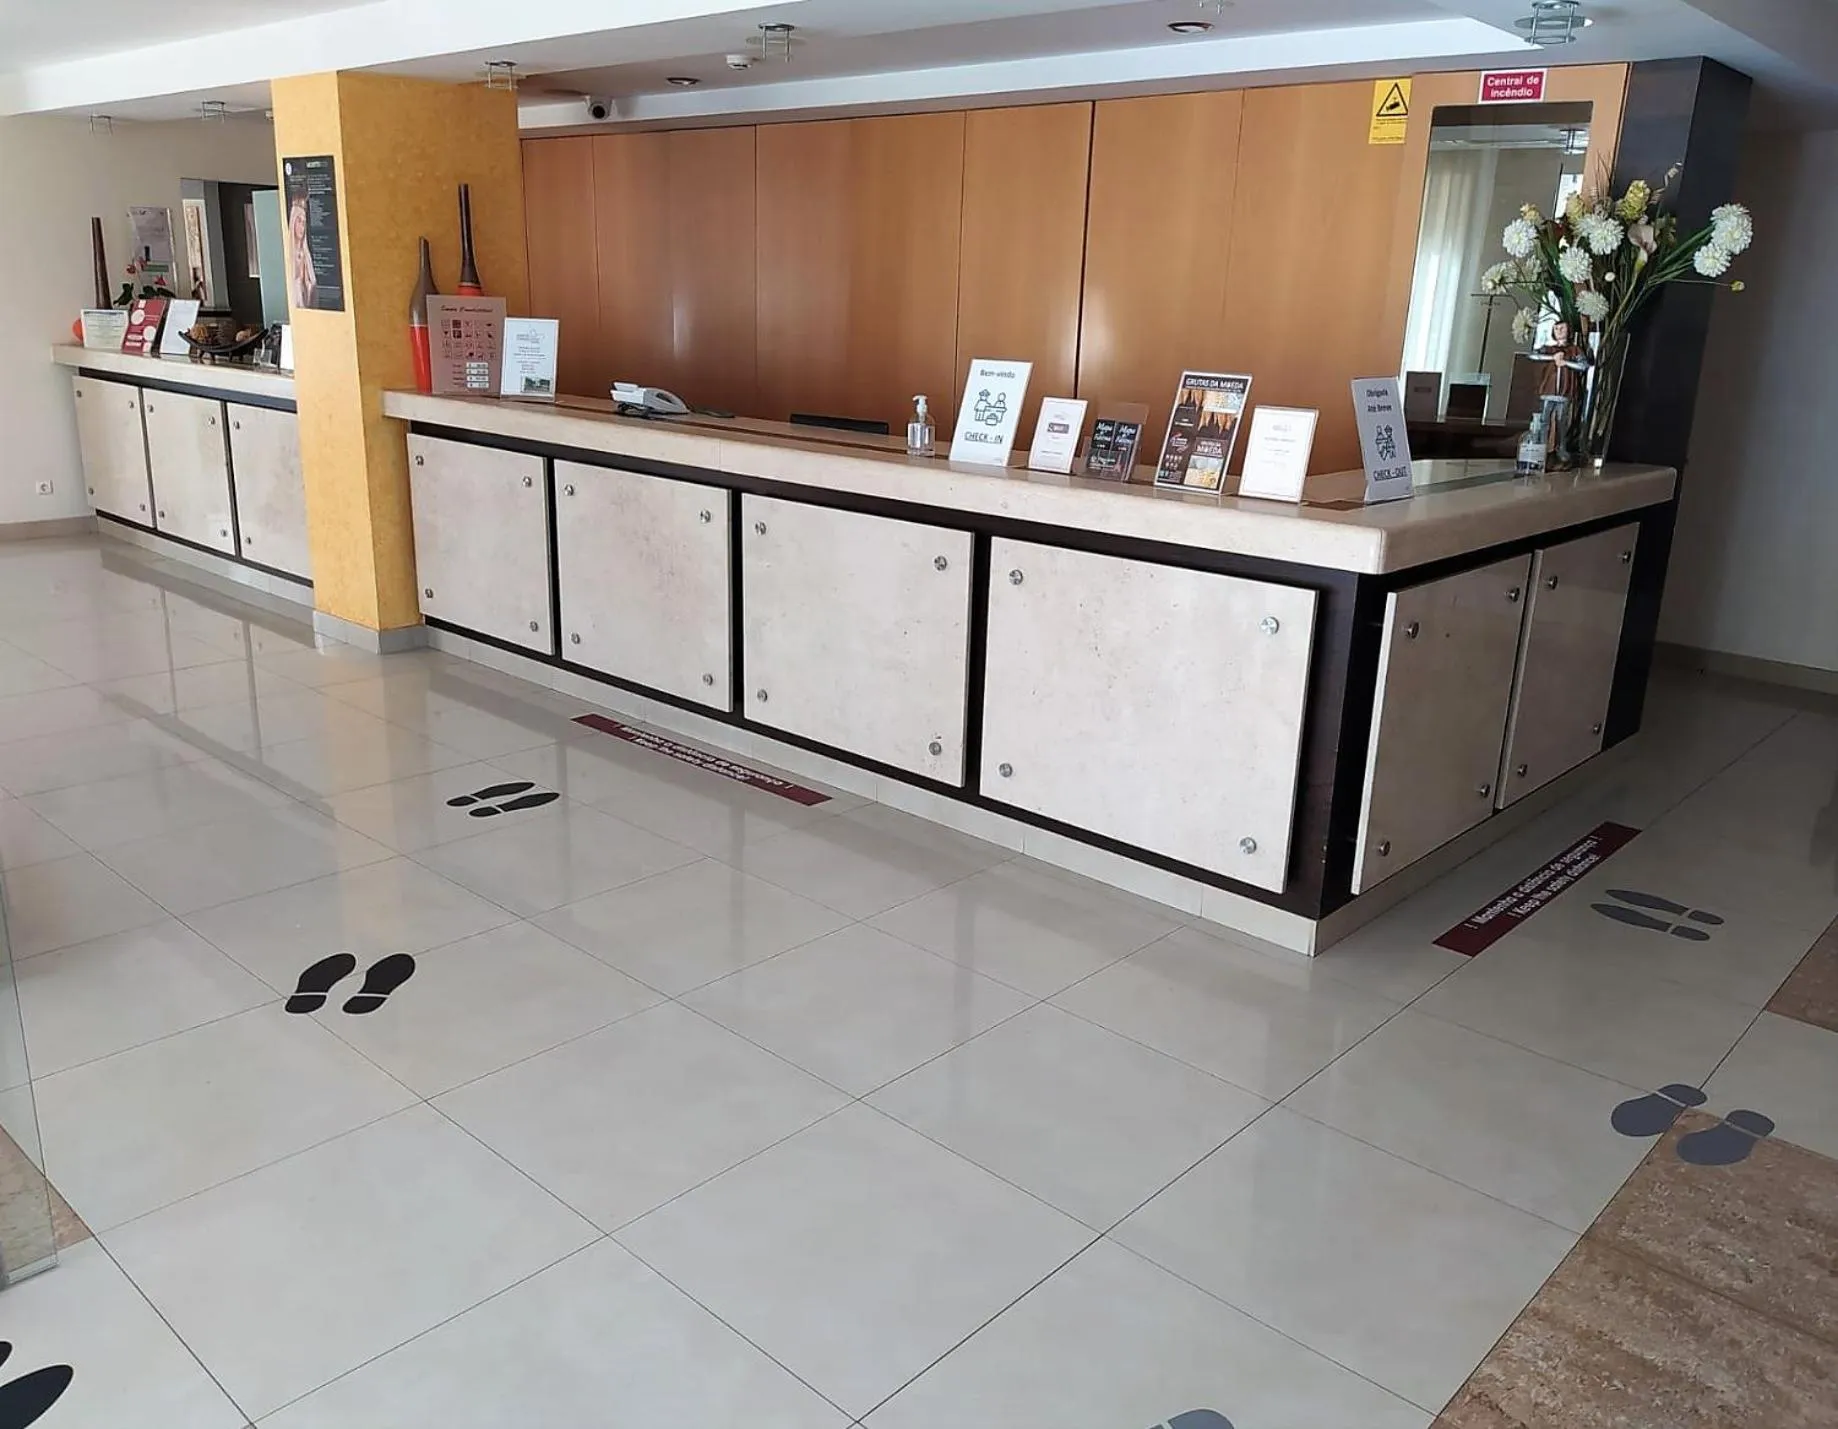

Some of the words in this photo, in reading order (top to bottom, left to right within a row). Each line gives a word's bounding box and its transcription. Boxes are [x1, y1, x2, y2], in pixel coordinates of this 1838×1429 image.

[1487, 75, 1523, 87] Central
[1526, 75, 1540, 85] de
[1490, 87, 1534, 98] incêndio
[1209, 379, 1219, 388] DA
[964, 431, 989, 442] CHECK
